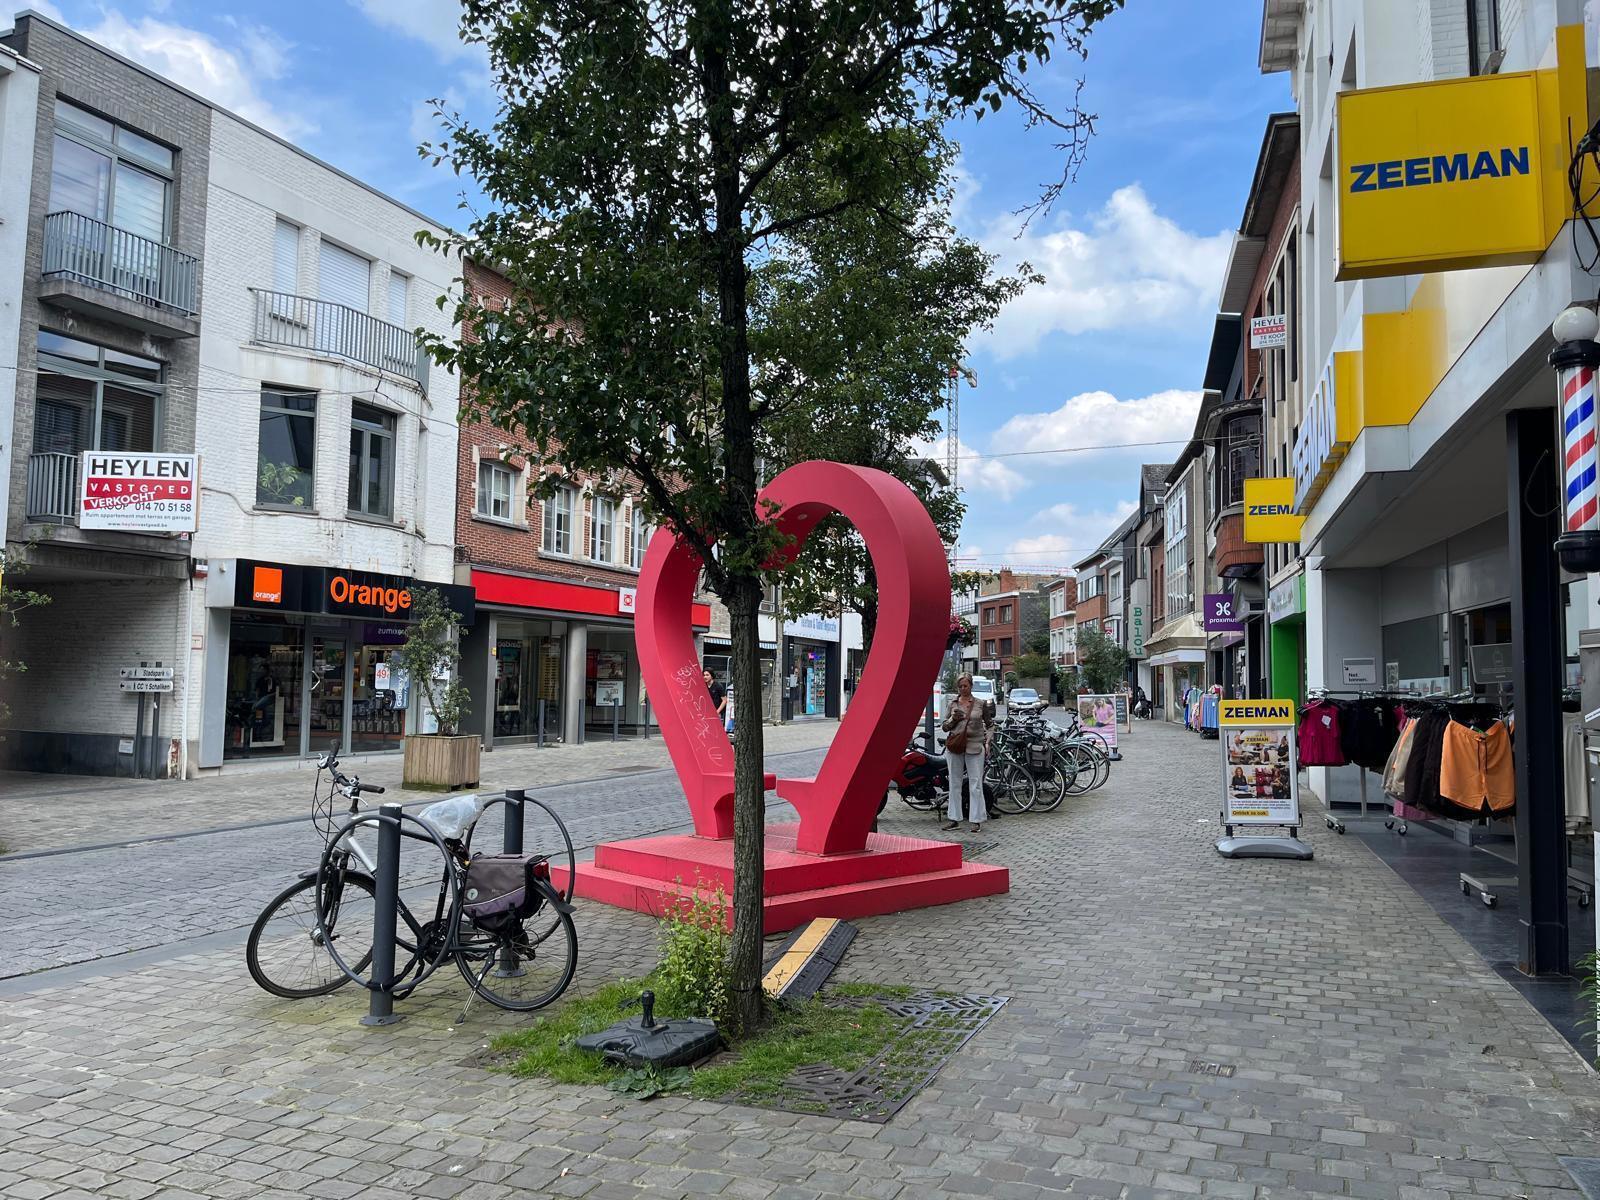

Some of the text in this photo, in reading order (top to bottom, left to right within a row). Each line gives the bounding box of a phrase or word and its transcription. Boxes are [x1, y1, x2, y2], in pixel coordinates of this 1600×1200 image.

[1349, 146, 1530, 194] ZEEMAN
[91, 458, 189, 478] HEYLEN
[90, 483, 189, 495] VASTGOED
[90, 491, 156, 508] VERKOCHT
[135, 502, 151, 511] 014
[154, 502, 165, 511] 70
[168, 503, 177, 511] 51
[180, 503, 192, 512] 58
[256, 592, 279, 602] orange
[330, 576, 412, 613] Orange
[1133, 607, 1143, 655] Balou
[1224, 706, 1289, 718] ZEEMAN
